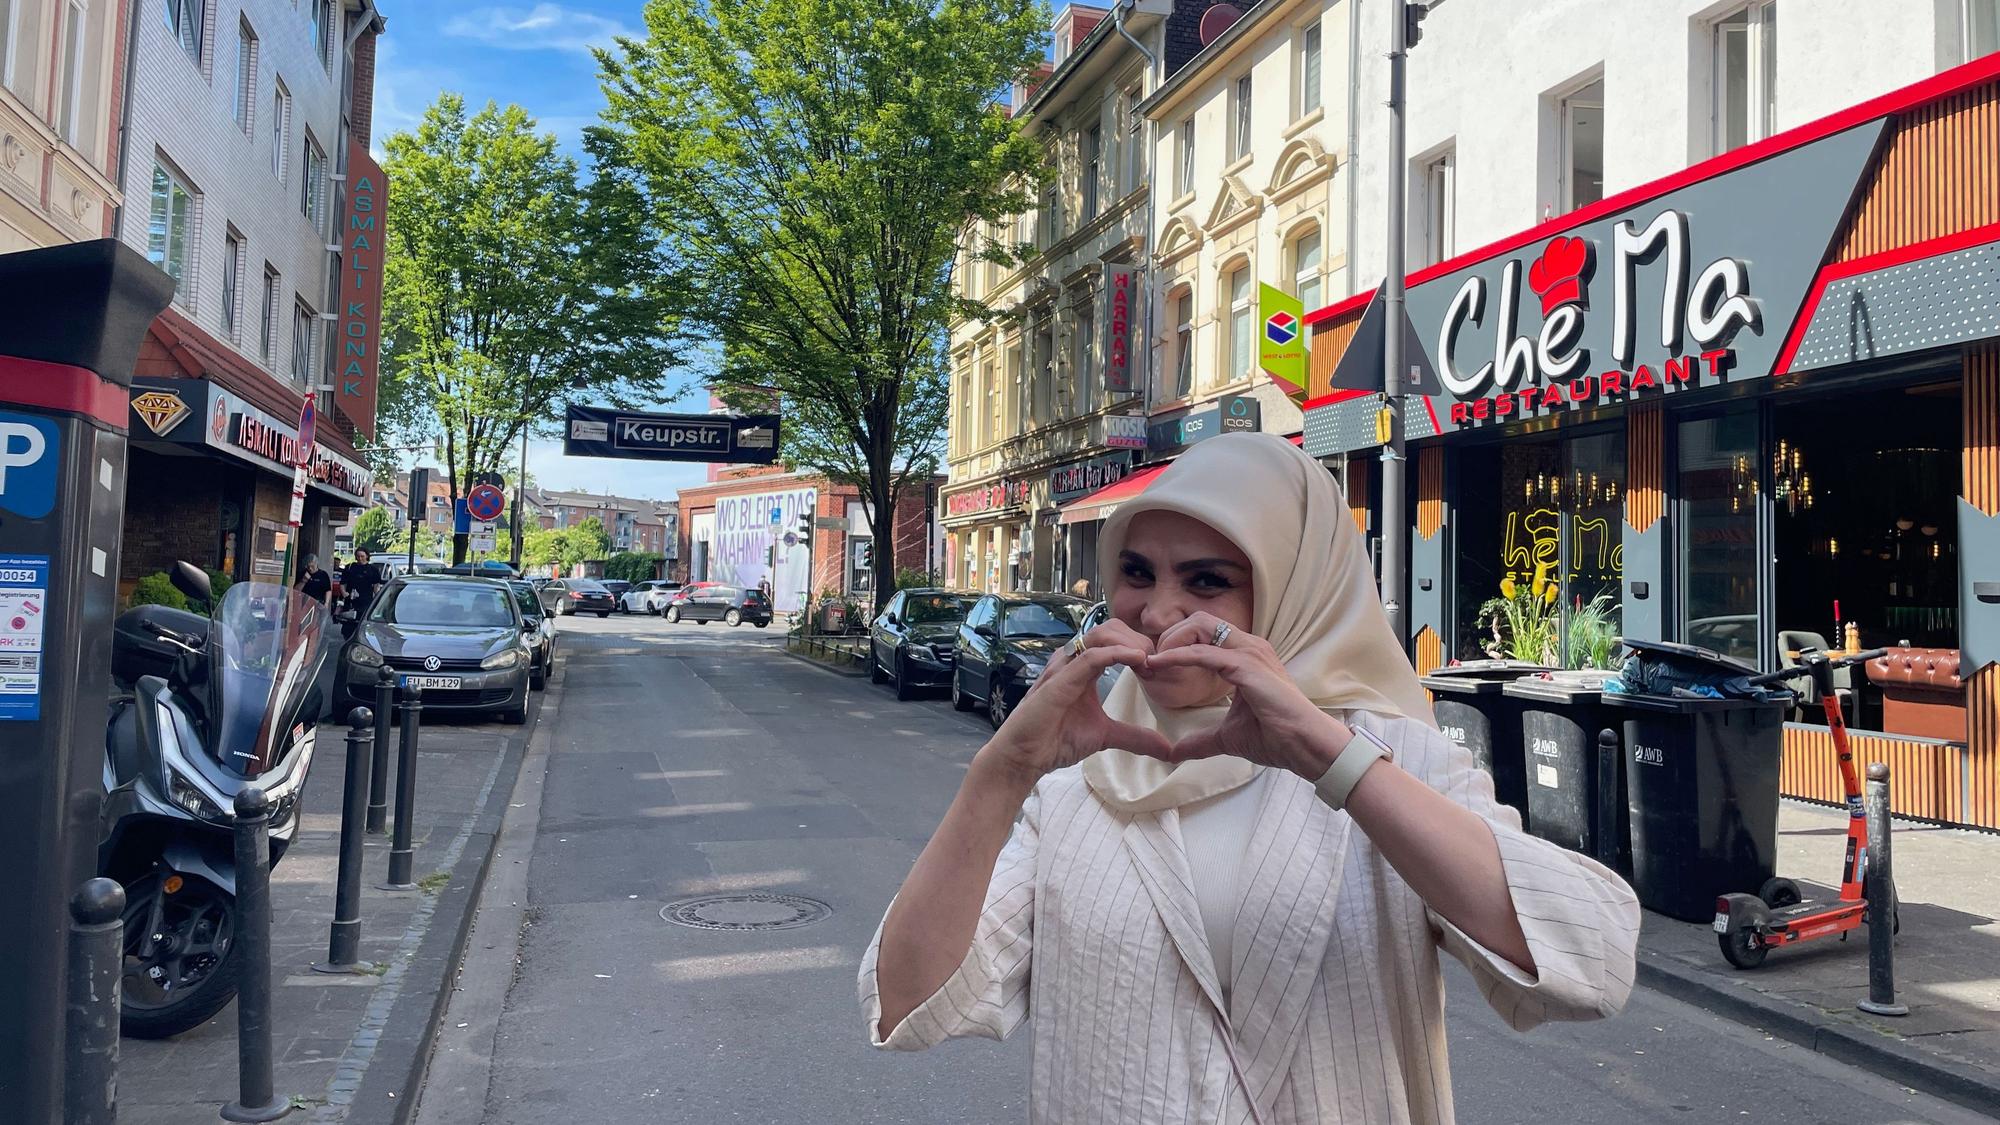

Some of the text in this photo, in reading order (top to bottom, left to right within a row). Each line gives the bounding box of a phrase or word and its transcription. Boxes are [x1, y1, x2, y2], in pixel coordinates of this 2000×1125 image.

[343, 176, 376, 398] ASMALI KONAK
[1438, 208, 1764, 399] Che Ma
[1112, 271, 1129, 368] HARRAN
[1451, 349, 1737, 426] RESTAURANT
[1107, 416, 1147, 438] KIOSK
[1185, 419, 1203, 433] IQOS
[1223, 418, 1253, 428] IQOS
[623, 422, 721, 447] Keupstr.
[717, 499, 736, 531] WO
[426, 678, 439, 688] BM
[441, 679, 459, 688] 129
[1449, 727, 1465, 740] AWB
[233, 750, 260, 761] HONDA
[1540, 740, 1558, 754] AWB
[1644, 747, 1663, 762] AWB
